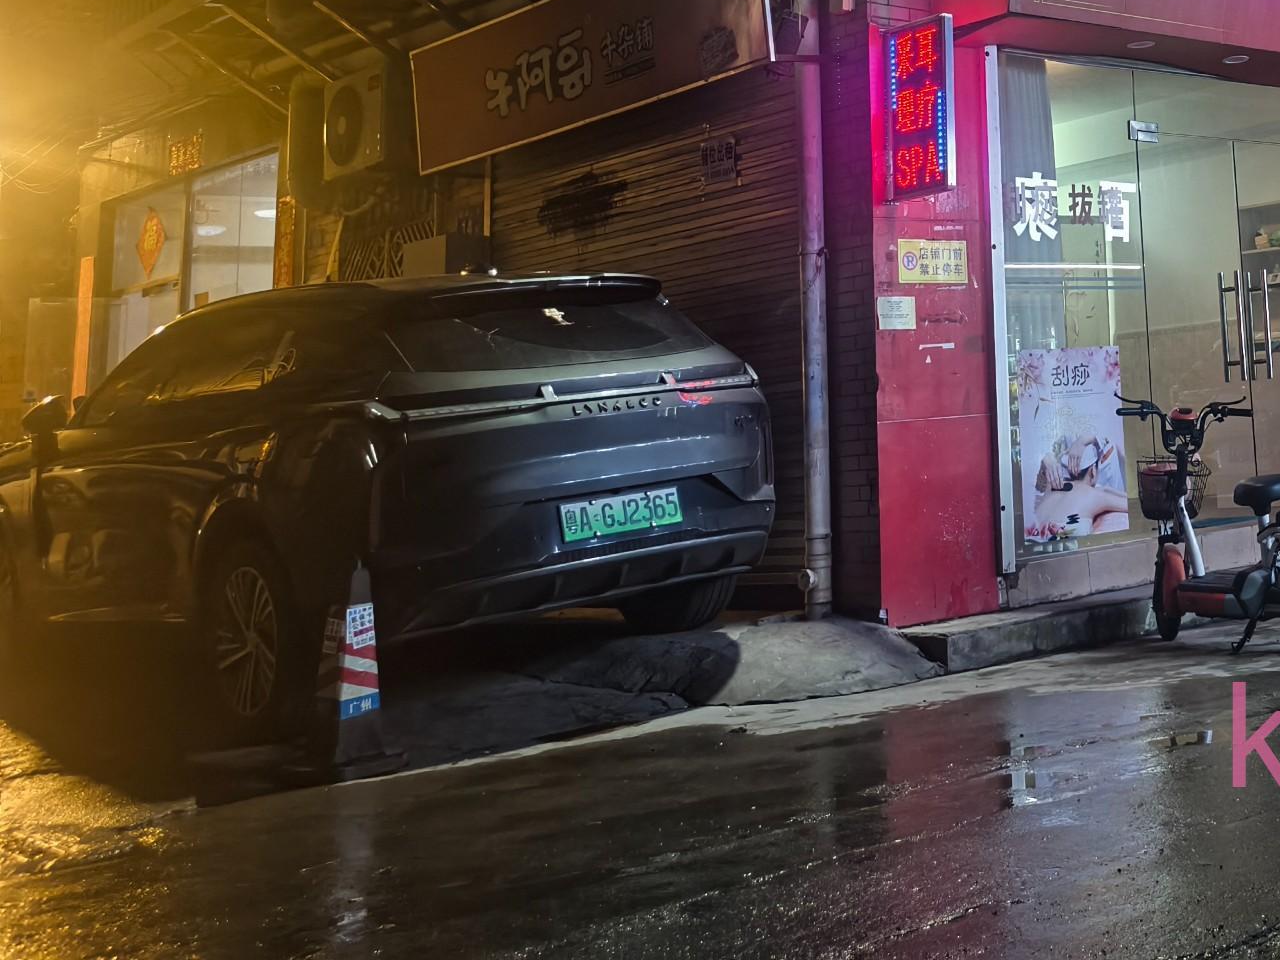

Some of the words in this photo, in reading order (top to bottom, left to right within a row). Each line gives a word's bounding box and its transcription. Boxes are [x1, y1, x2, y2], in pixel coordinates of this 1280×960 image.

[895, 27, 937, 80] 采耳
[895, 81, 938, 132] 理疗
[896, 141, 941, 187] SPA
[919, 247, 963, 262] 店铺门前
[919, 262, 964, 277] 禁止停车
[1051, 363, 1091, 387] 刮痧
[349, 698, 372, 714] 广州
